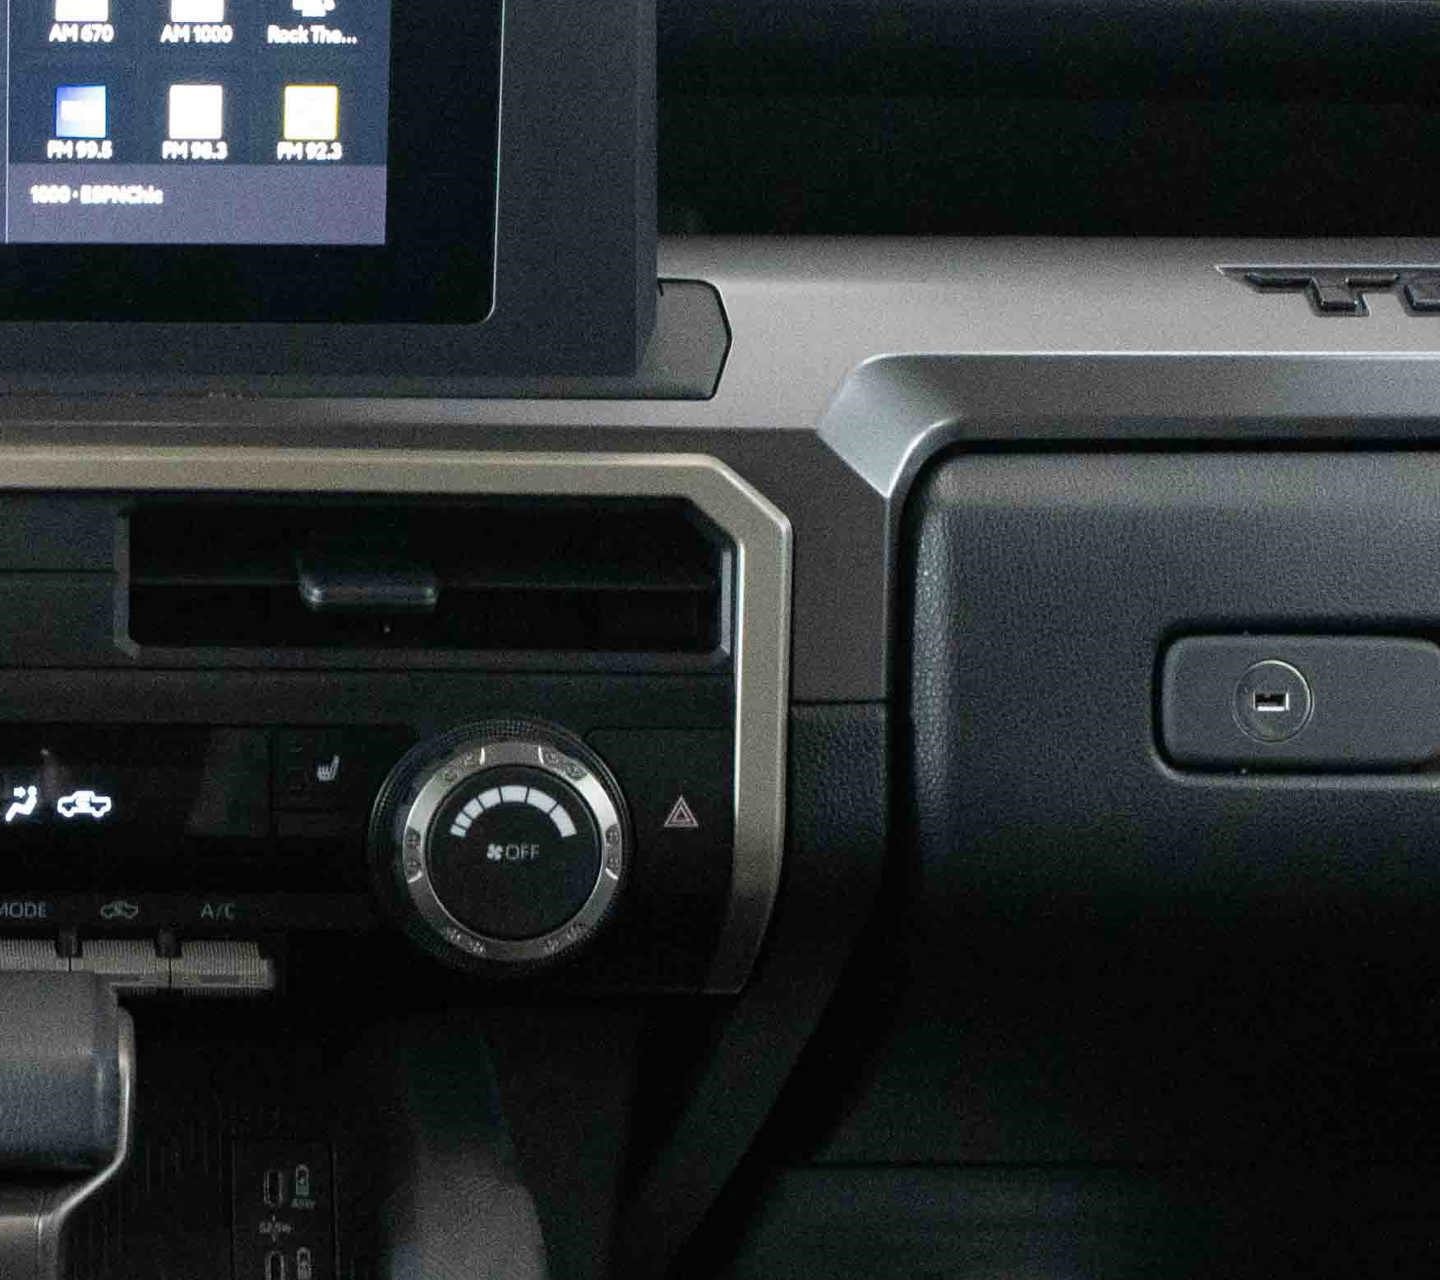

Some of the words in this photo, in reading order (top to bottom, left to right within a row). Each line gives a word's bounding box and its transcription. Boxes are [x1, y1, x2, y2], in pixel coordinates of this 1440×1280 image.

[49, 23, 79, 43] AM
[81, 23, 115, 43] 670
[159, 23, 191, 44] AM
[193, 23, 234, 44] 1000
[266, 24, 309, 45] Rock
[46, 140, 73, 160] FM
[161, 141, 188, 160] FM
[276, 141, 303, 161] FM
[505, 843, 540, 862] OFF
[200, 902, 236, 920] A/C
